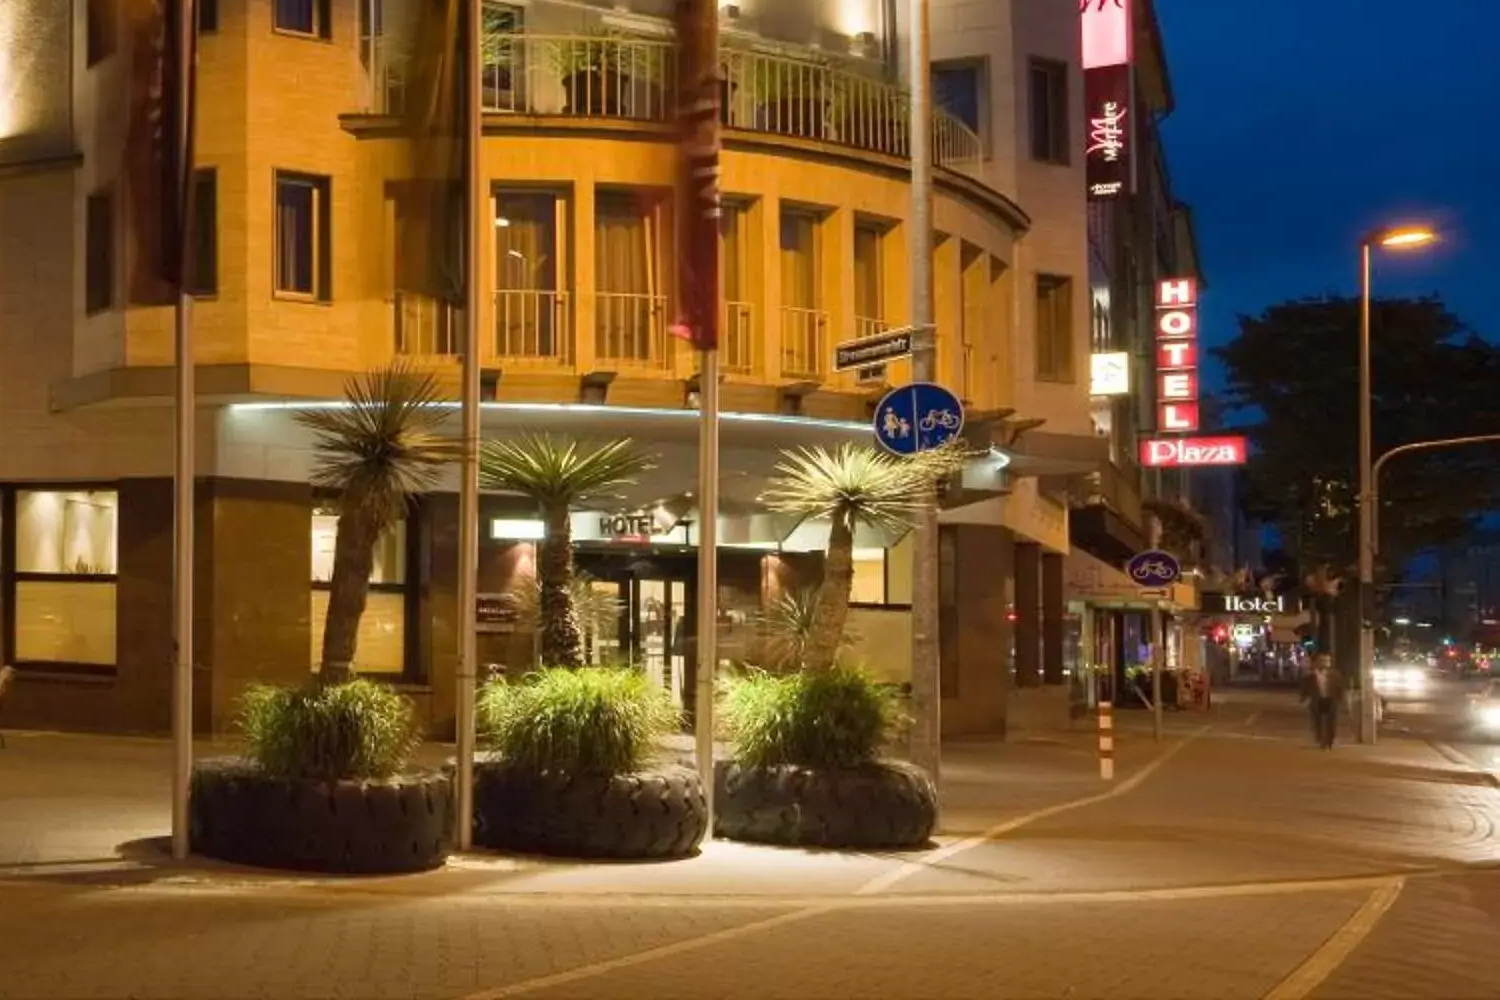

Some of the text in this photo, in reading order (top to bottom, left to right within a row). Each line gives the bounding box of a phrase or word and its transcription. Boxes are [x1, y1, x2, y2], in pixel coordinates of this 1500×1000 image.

[1159, 279, 1191, 429] HOTEL
[1147, 439, 1236, 465] Plaza
[599, 513, 662, 535] HOTEL
[1224, 594, 1284, 613] Hotel
